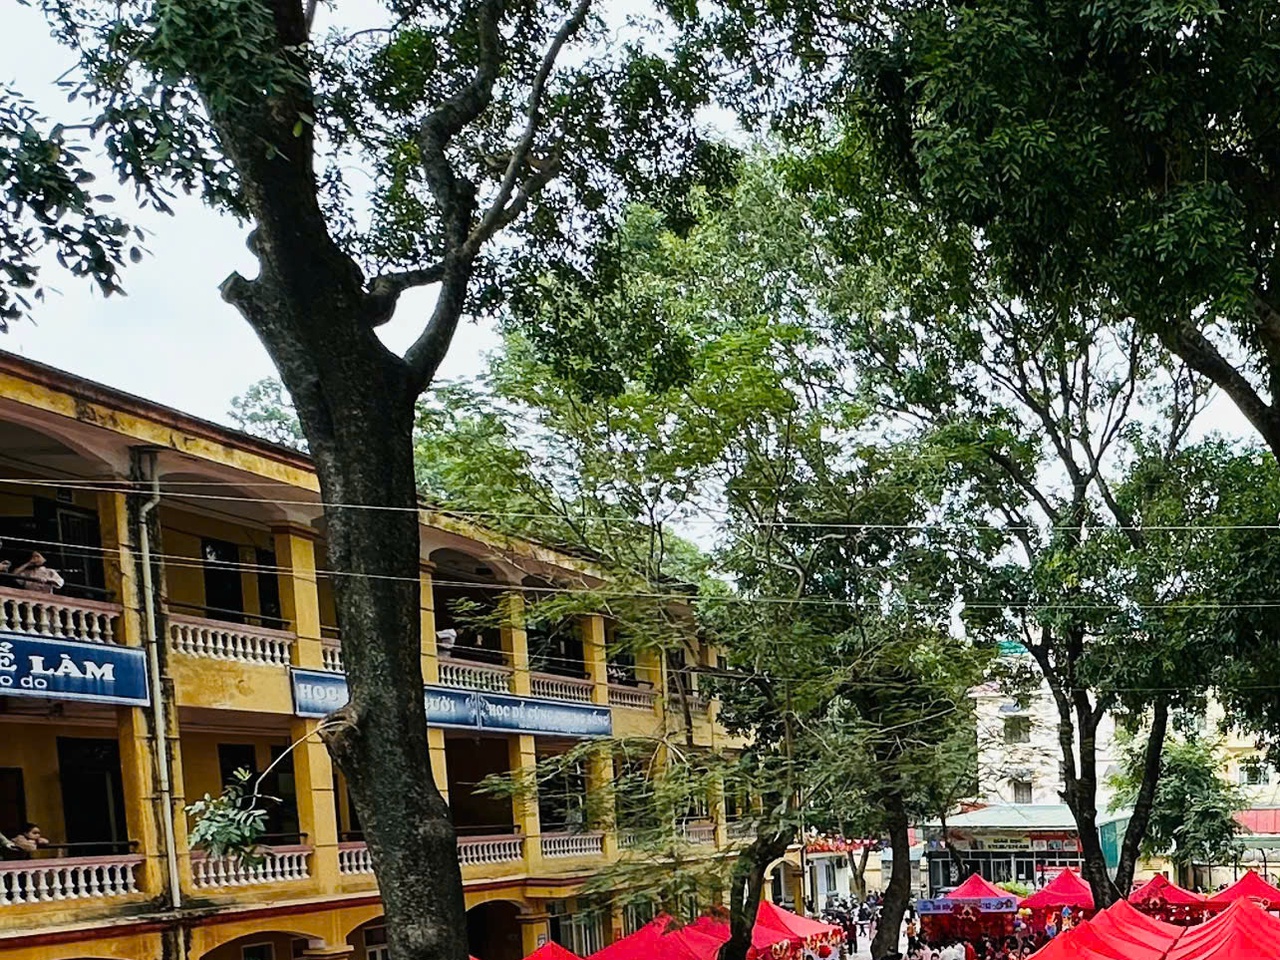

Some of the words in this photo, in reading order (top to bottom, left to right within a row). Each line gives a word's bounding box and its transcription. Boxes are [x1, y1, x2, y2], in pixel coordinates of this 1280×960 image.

[28, 653, 115, 681] LÀM
[20, 675, 47, 689] do
[299, 683, 338, 702] HỌC
[488, 703, 511, 720] HỌC
